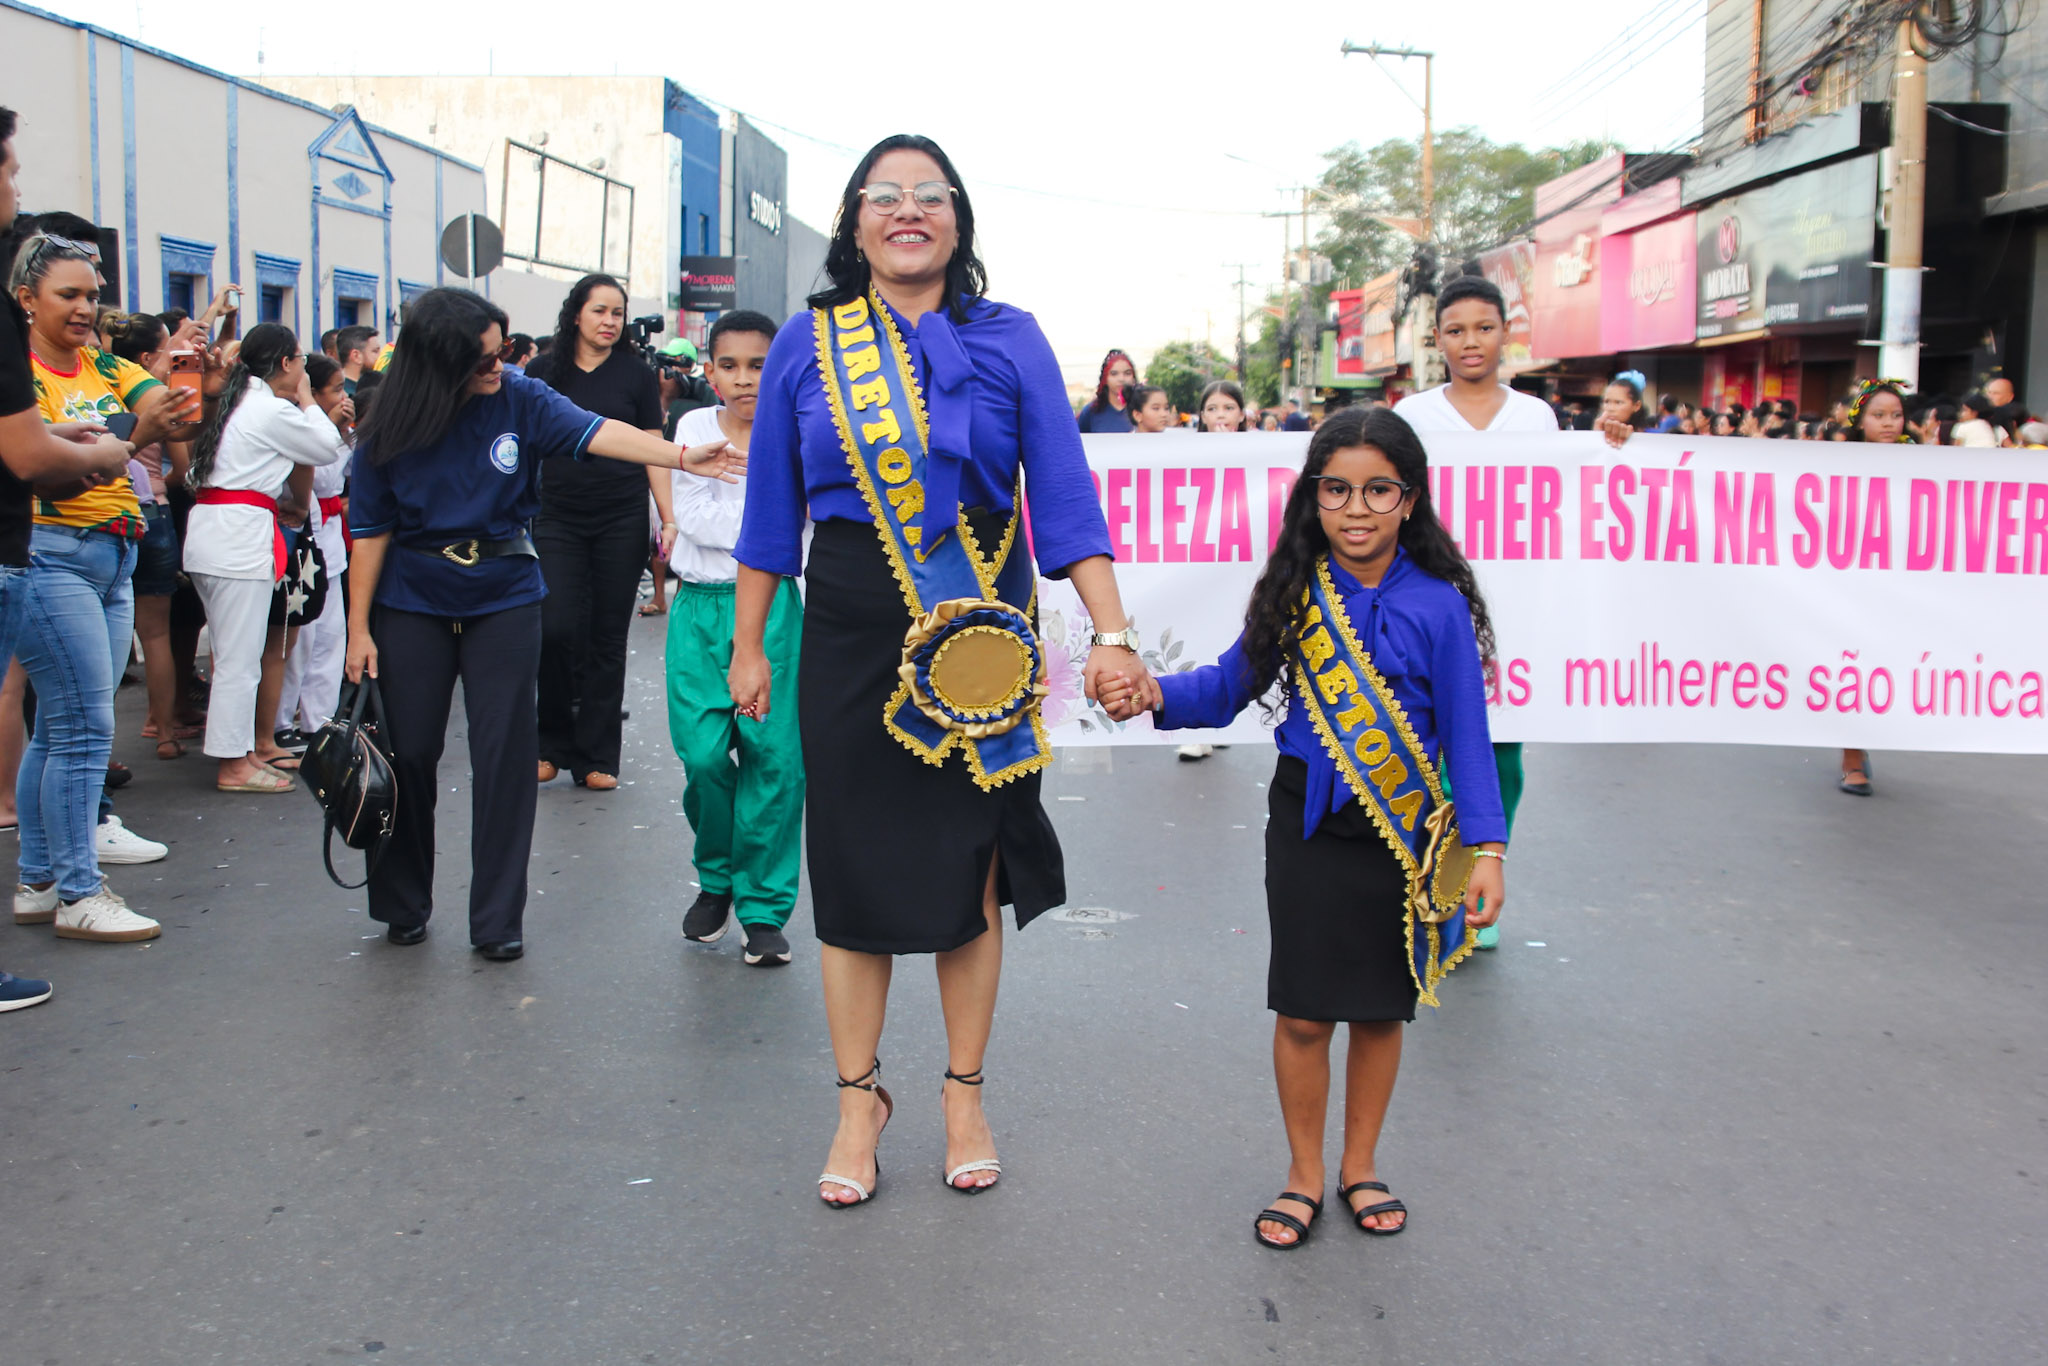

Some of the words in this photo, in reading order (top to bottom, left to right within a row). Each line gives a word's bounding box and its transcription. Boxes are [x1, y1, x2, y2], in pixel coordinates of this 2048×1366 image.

[688, 274, 735, 286] MORENA
[1090, 467, 1254, 563] ELEZA
[1580, 451, 1699, 563] ESTÁ
[1714, 471, 1779, 566] NA
[1792, 473, 1892, 570] SUA
[1906, 478, 2048, 575] DIVER
[1290, 583, 1424, 832] IRETORA
[1565, 641, 1789, 711] mulheres
[1806, 649, 1895, 715] são
[1912, 651, 2045, 719] única
